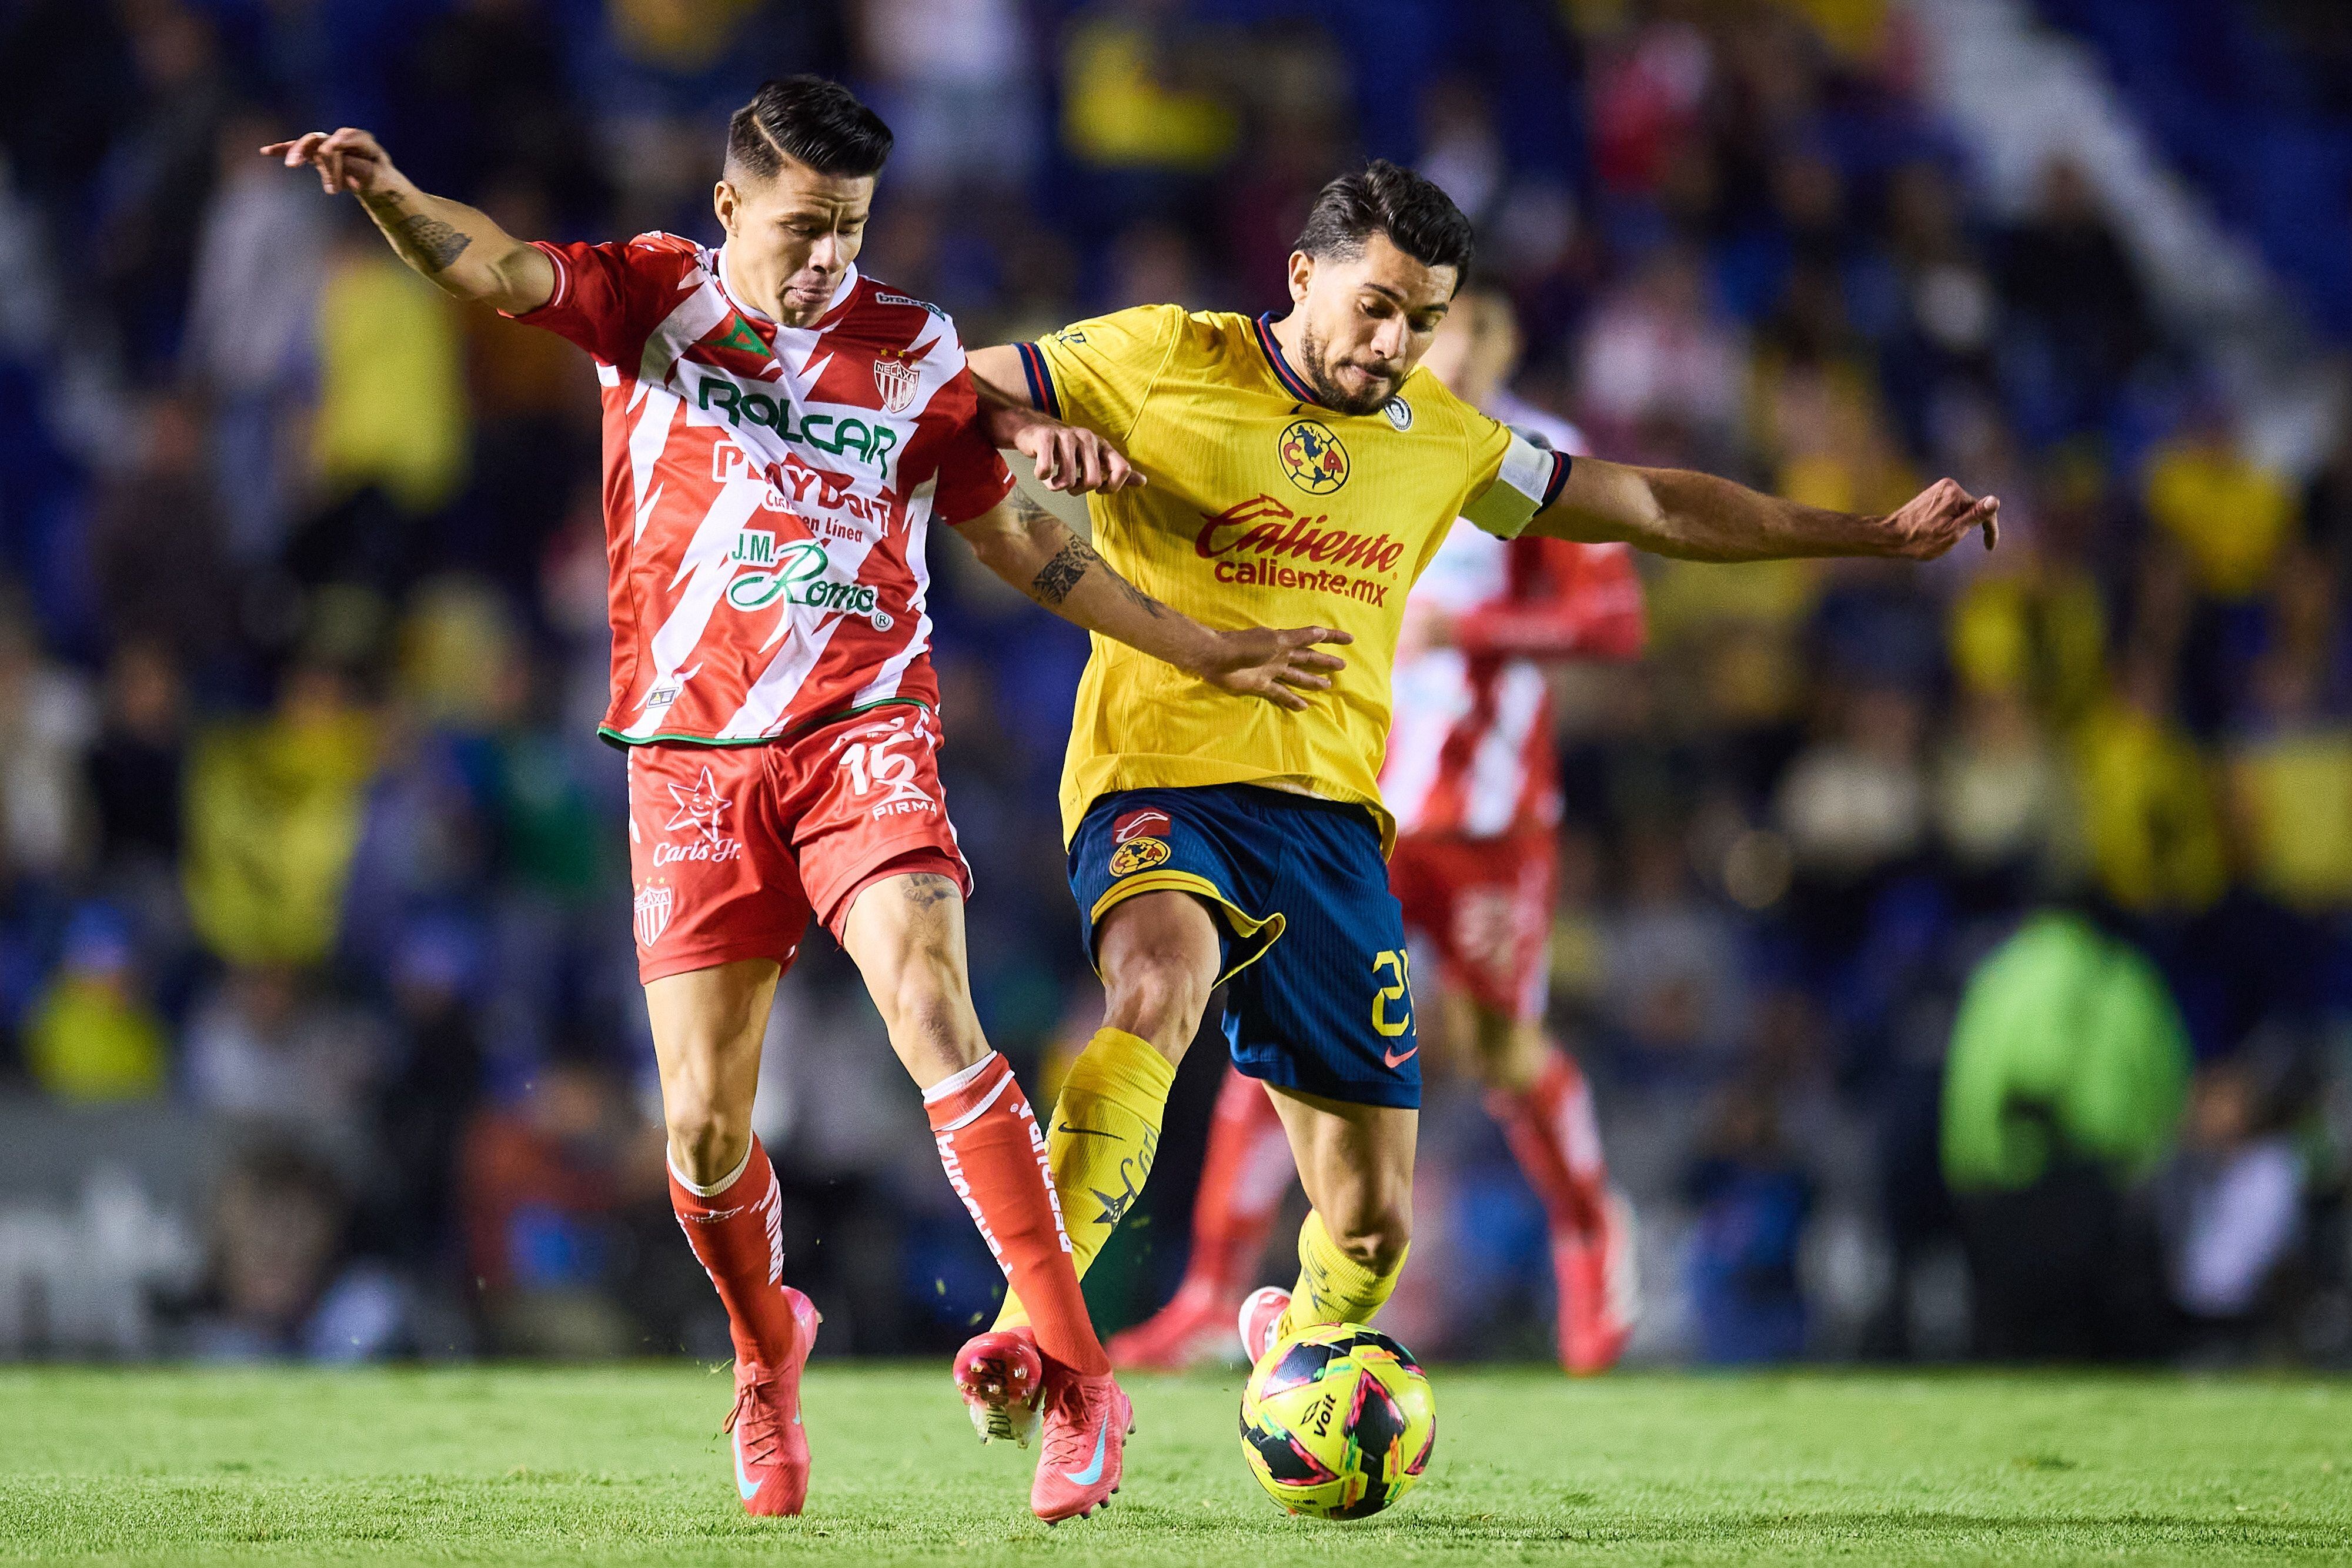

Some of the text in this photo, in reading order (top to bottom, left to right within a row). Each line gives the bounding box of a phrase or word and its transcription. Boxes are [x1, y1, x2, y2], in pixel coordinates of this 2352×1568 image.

[877, 363, 916, 384] NECAXA
[699, 376, 897, 480] ROLCAR
[732, 533, 774, 563] J.M.
[826, 517, 863, 543] Línea
[1195, 493, 1405, 573] Caliente
[731, 541, 875, 613] Romo
[1214, 558, 1389, 608] caliente.mx
[838, 731, 916, 795] 15
[872, 801, 937, 821] PIRMA
[653, 838, 742, 868] Carl's Jr.
[1314, 1393, 1337, 1437] Voit
